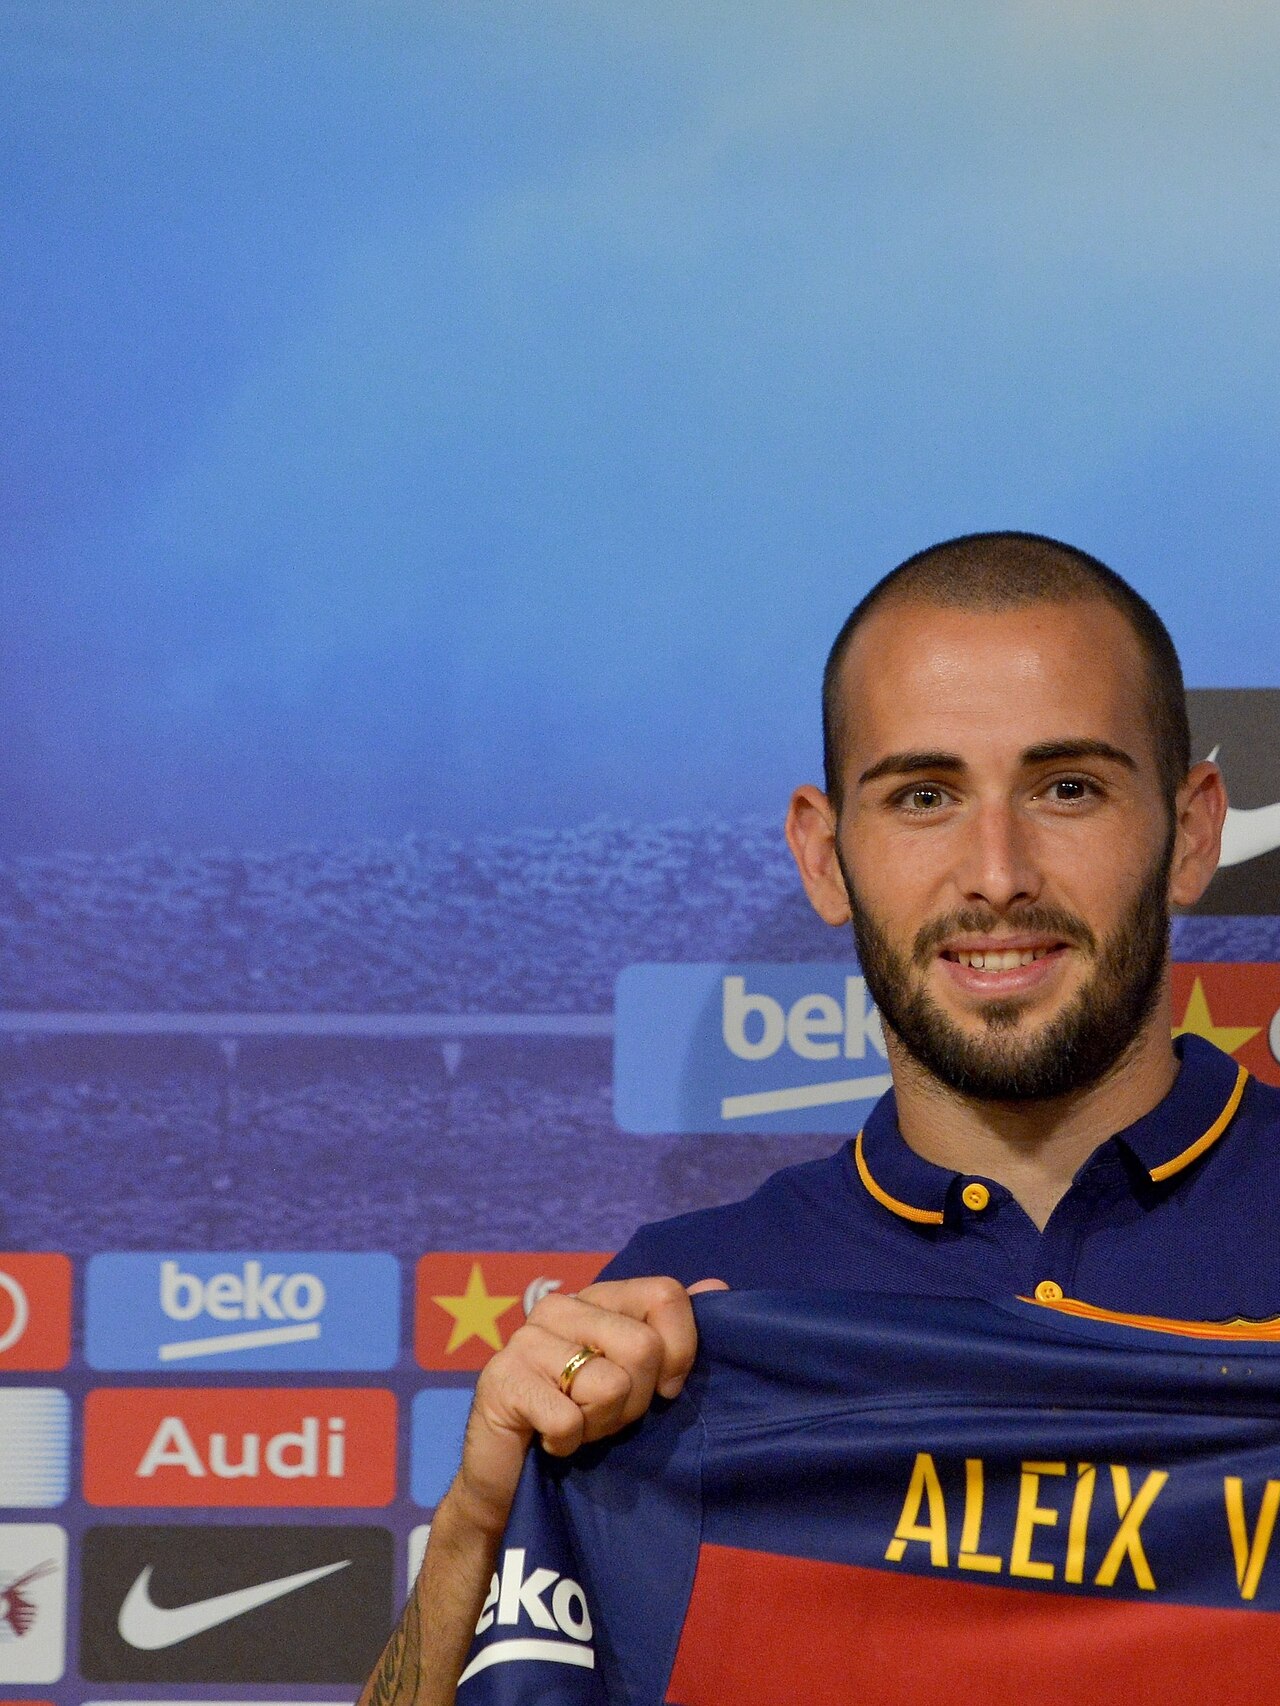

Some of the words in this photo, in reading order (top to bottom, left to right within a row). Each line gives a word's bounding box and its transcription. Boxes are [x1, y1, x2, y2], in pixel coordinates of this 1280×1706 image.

[722, 975, 889, 1060] bek
[159, 1260, 326, 1321] beko
[136, 1416, 347, 1478] Audi
[884, 1452, 1169, 1591] ALEIX
[475, 1548, 593, 1642] eko
